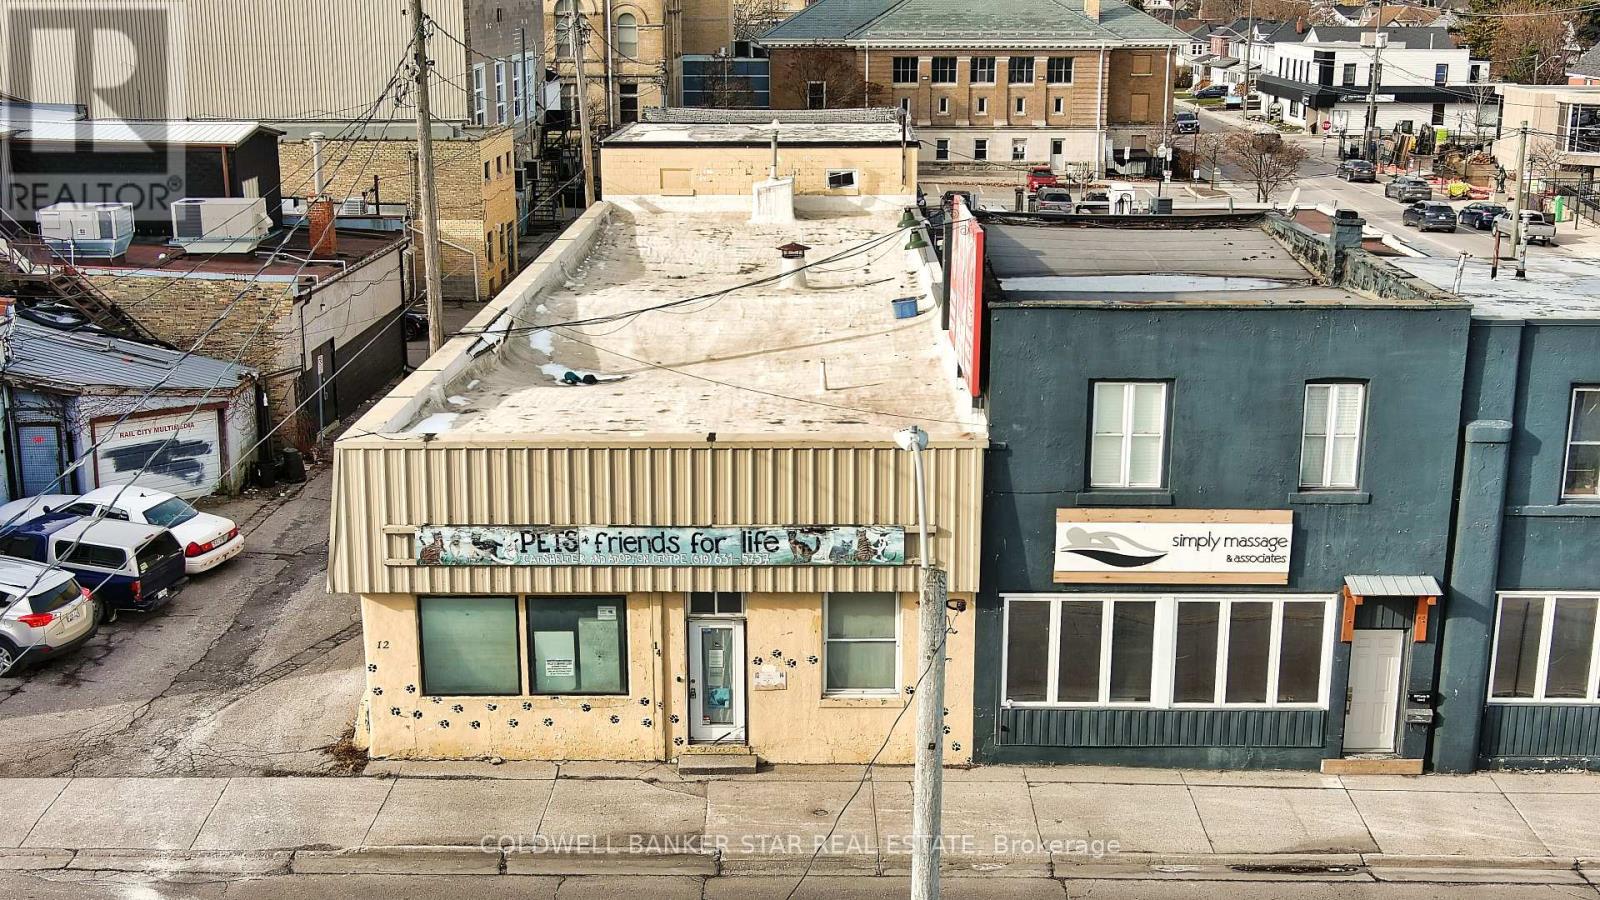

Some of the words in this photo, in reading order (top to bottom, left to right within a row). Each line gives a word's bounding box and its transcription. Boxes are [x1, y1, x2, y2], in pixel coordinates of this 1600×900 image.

[137, 428, 152, 436] CITY
[594, 531, 680, 553] friends
[691, 532, 727, 553] for
[742, 531, 780, 553] life
[1172, 531, 1220, 552] simply
[1223, 537, 1288, 552] massage
[1226, 554, 1232, 563] &
[1233, 553, 1287, 563] associates
[377, 640, 390, 649] 12
